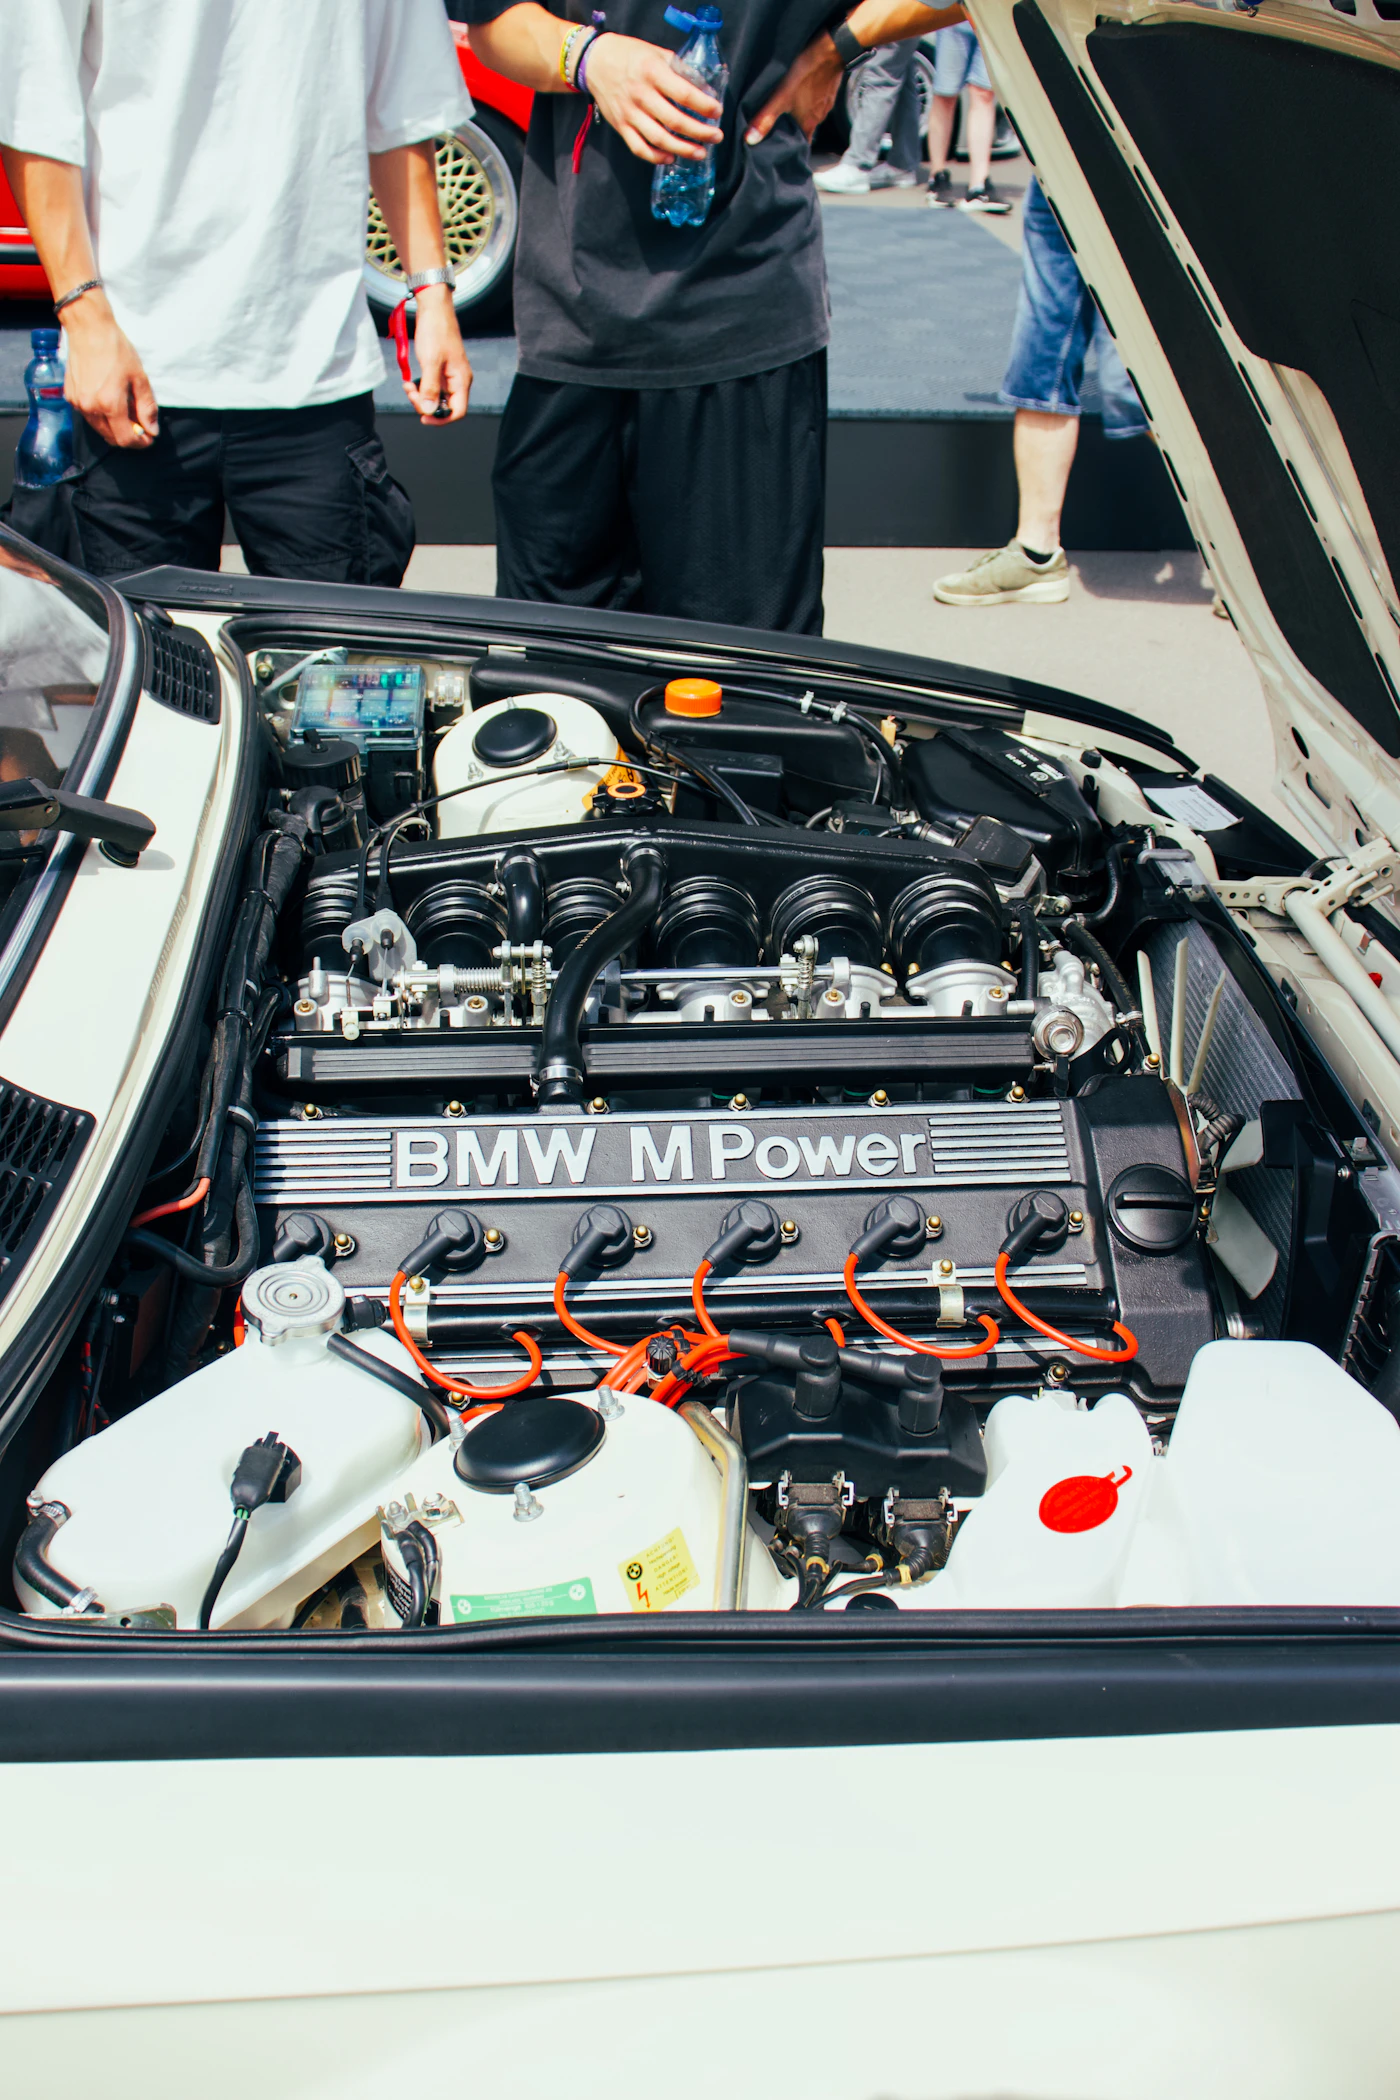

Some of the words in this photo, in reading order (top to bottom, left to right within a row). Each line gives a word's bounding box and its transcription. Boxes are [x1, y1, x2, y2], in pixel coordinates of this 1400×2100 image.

[396, 1127, 597, 1188] BMW
[630, 1125, 695, 1182] M
[708, 1124, 927, 1180] Power
